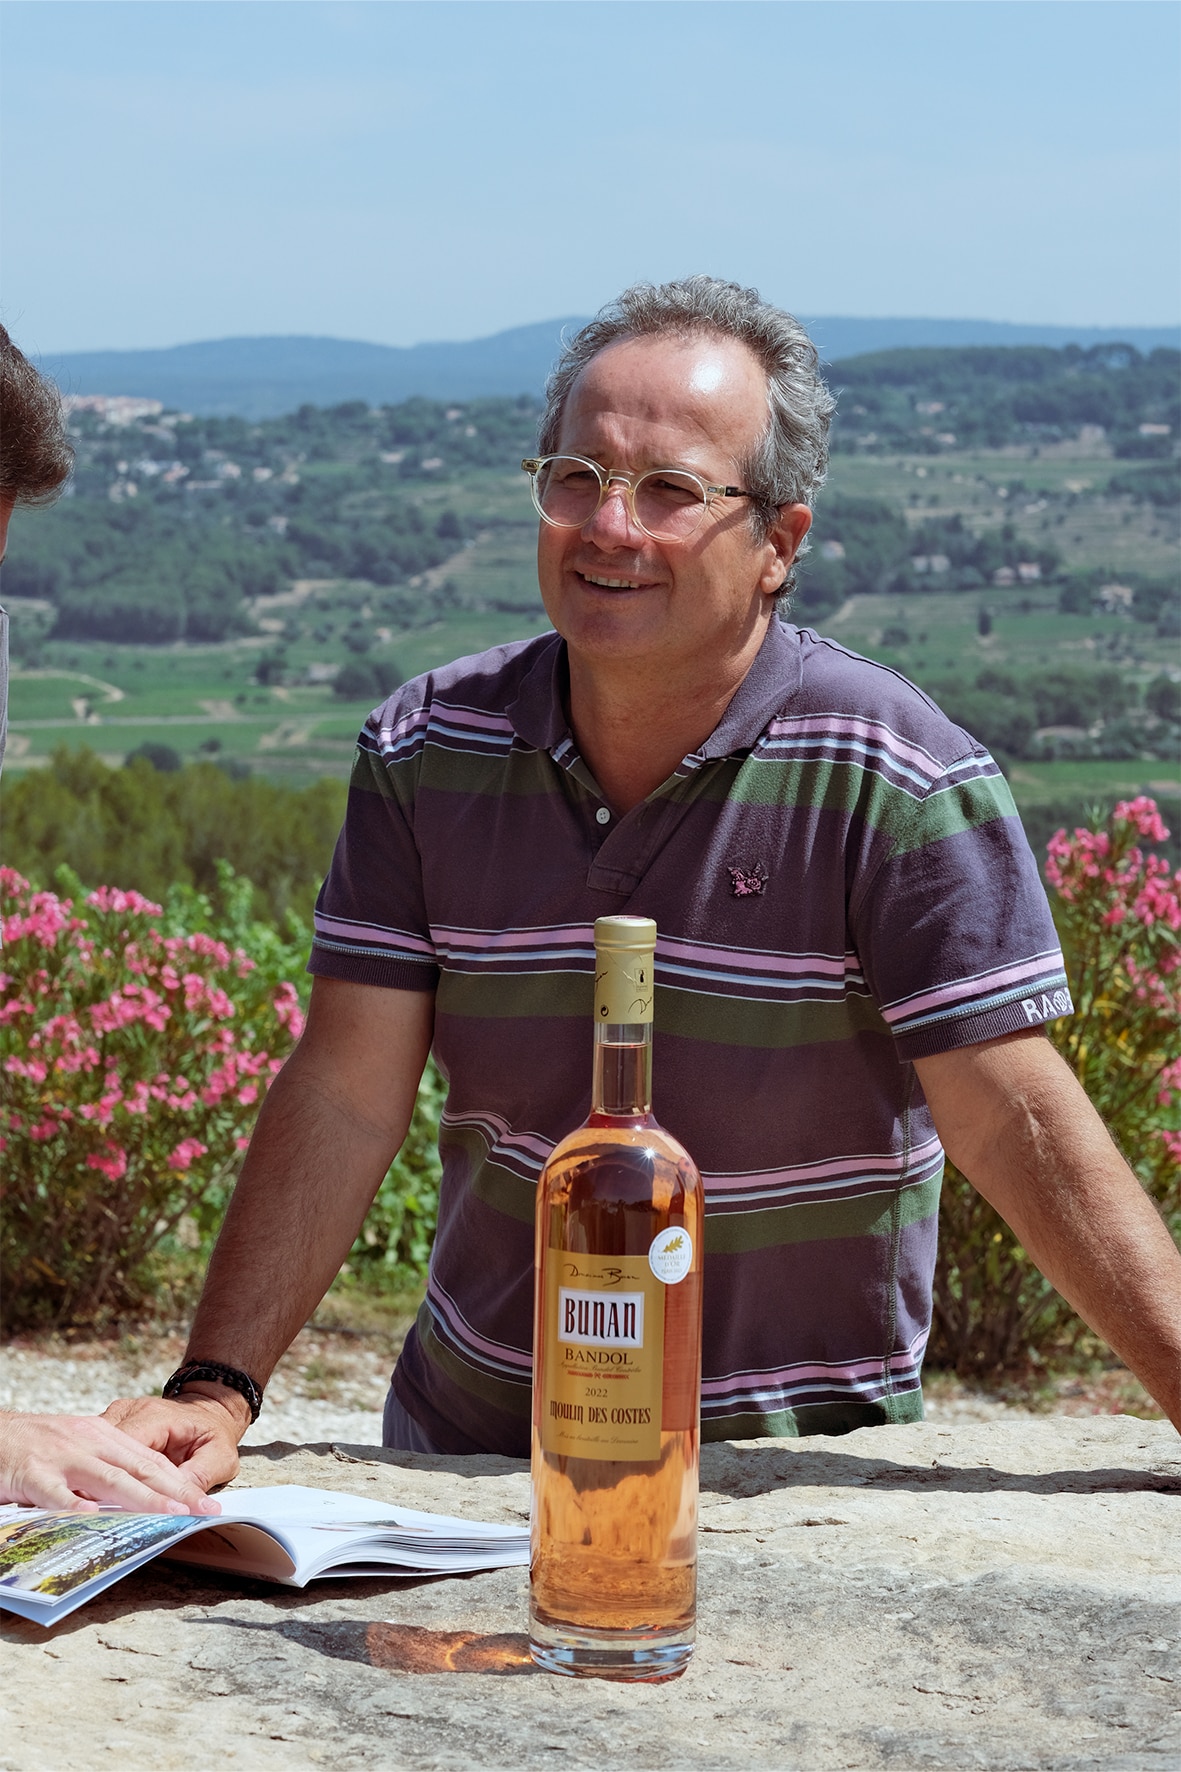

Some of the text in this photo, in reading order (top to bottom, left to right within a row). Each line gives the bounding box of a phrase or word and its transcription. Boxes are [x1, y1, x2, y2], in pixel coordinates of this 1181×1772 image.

[564, 1298, 636, 1340] BUNAN
[565, 1348, 634, 1365] BANDOL
[585, 1387, 608, 1398] 2022
[588, 1407, 608, 1424] DES
[611, 1407, 651, 1425] COSTES
